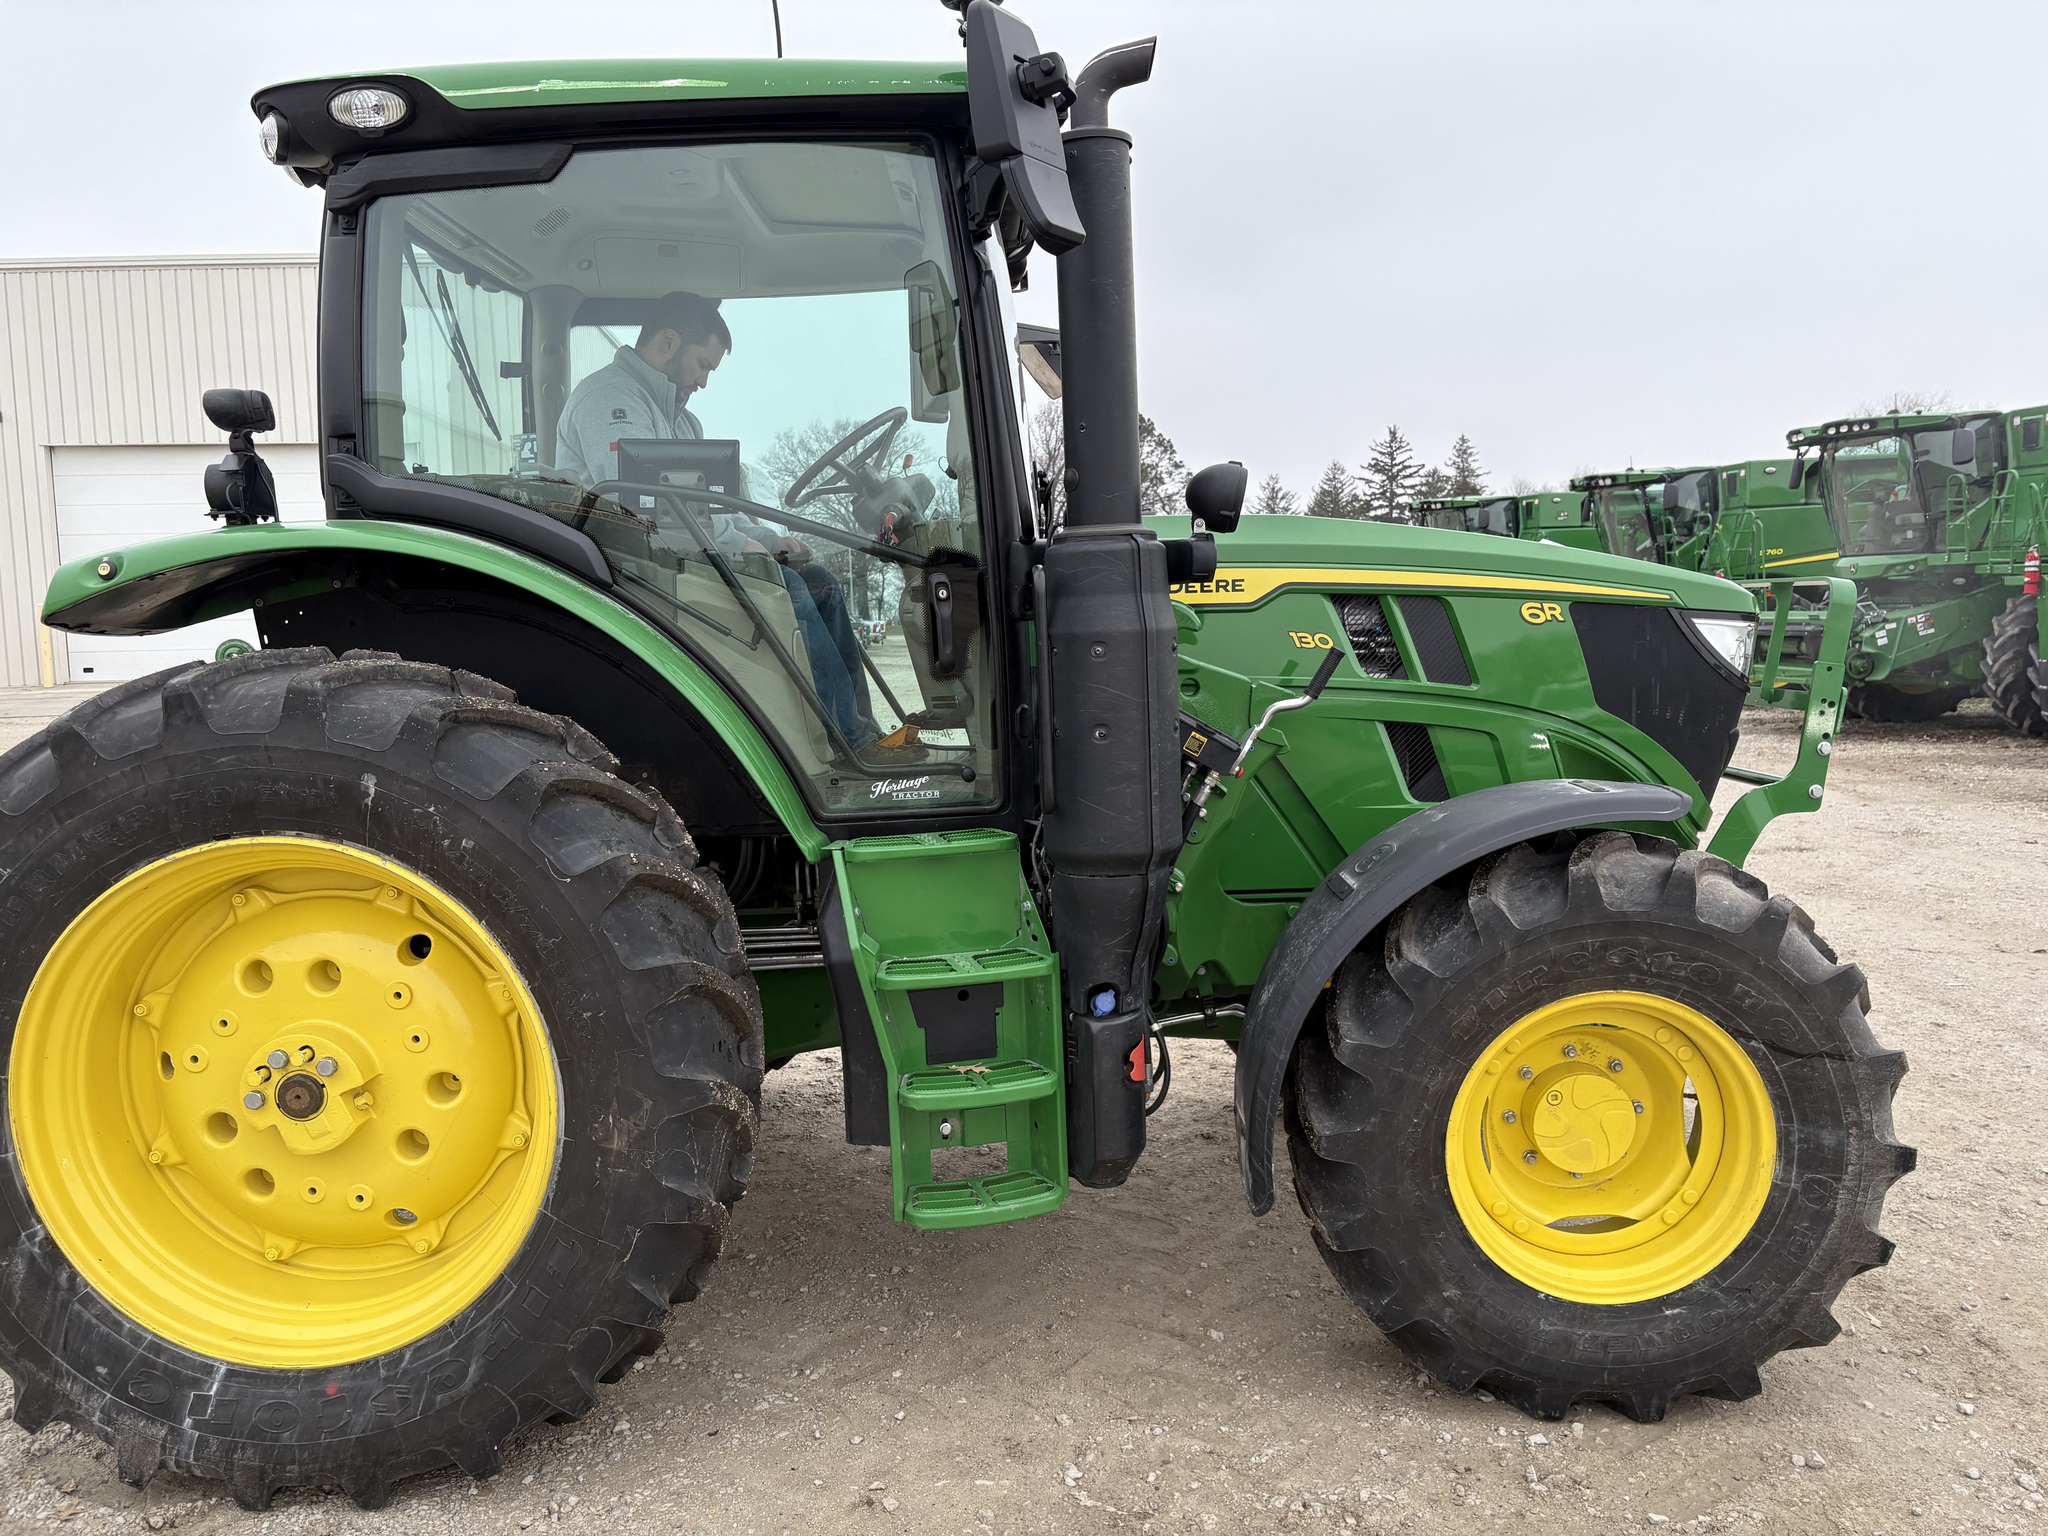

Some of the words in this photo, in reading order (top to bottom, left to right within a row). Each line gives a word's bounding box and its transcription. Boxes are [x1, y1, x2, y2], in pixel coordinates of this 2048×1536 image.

[1169, 579, 1245, 594] DEERE
[1520, 601, 1566, 626] 6R
[1287, 630, 1335, 650] 130
[870, 775, 930, 799] Heritage
[891, 790, 940, 801] TRACTOR
